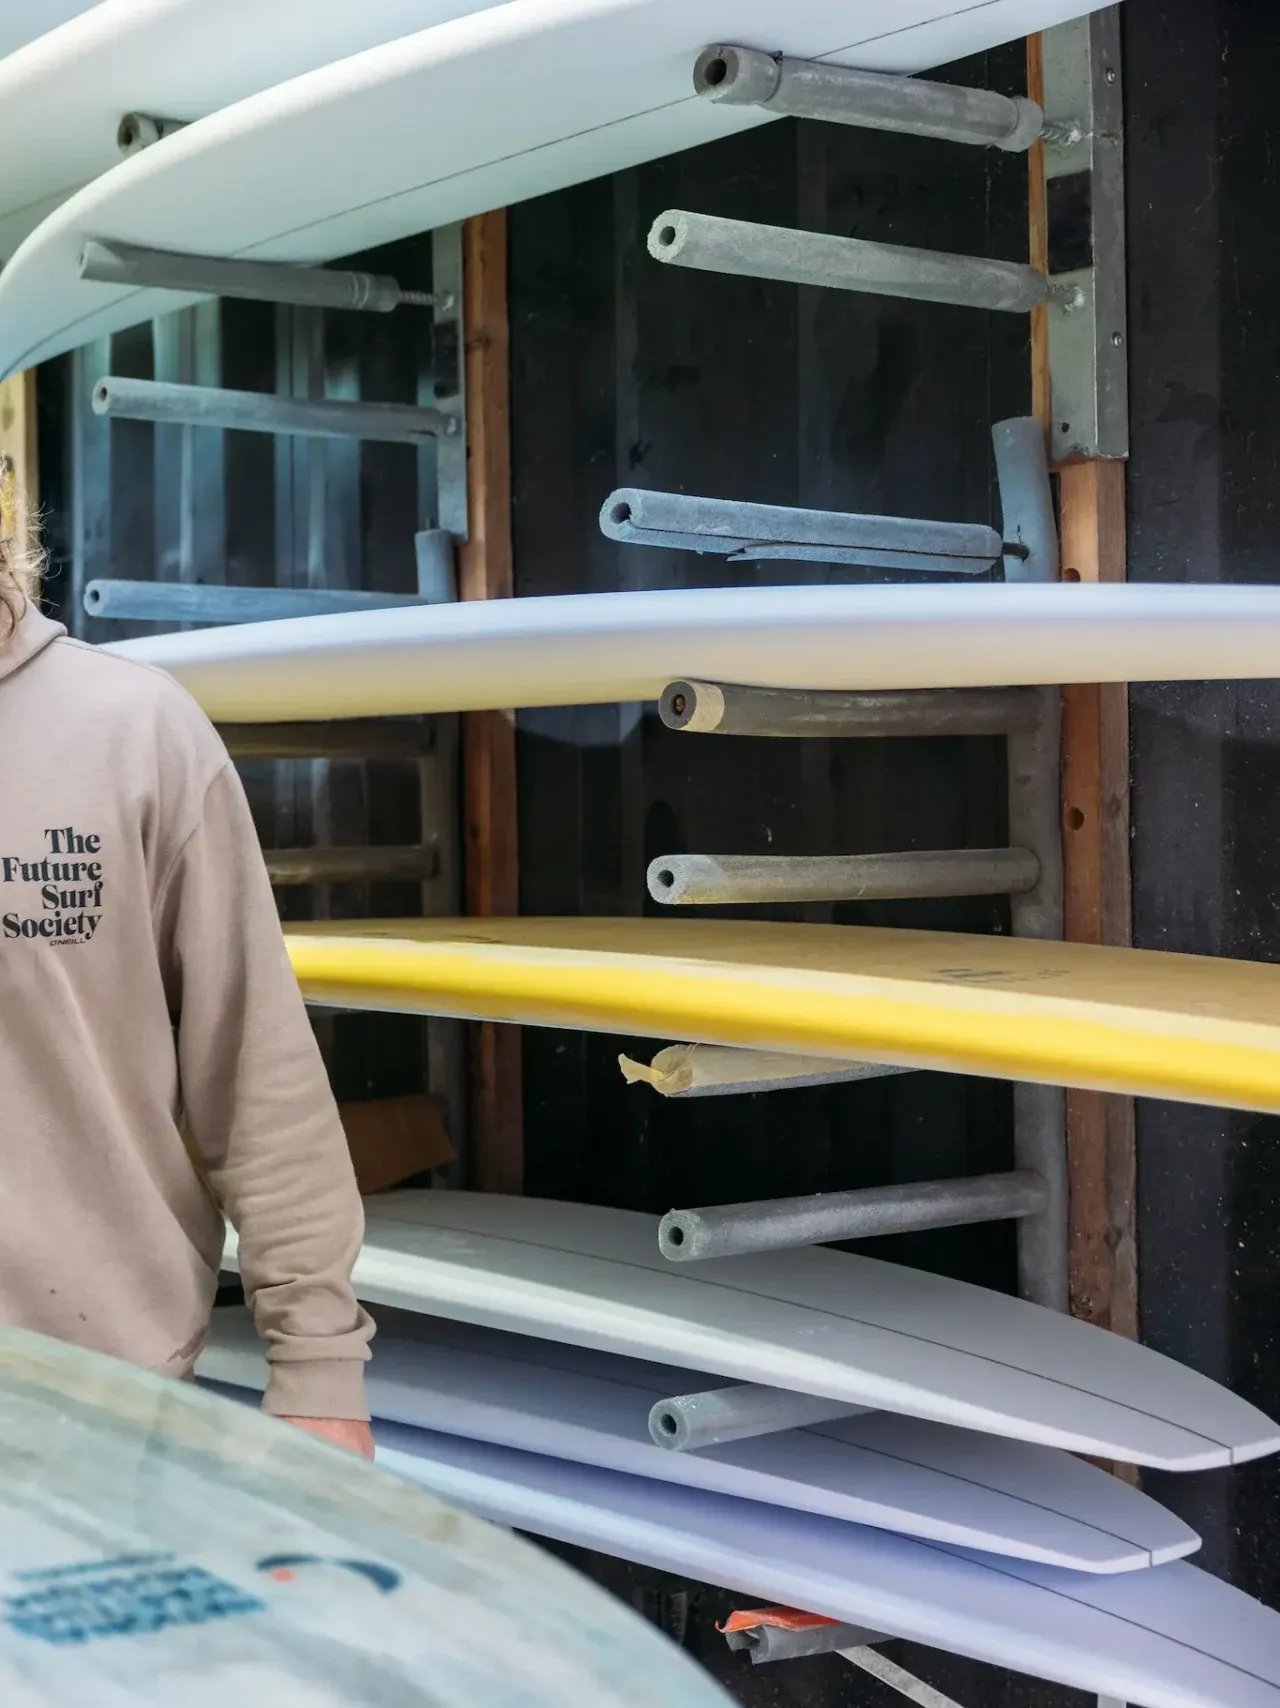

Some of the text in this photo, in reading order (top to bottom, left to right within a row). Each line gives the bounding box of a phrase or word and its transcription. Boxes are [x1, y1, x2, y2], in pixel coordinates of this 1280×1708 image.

[44, 826, 101, 854] The
[0, 856, 103, 883] Future
[41, 880, 104, 910] Surf
[2, 910, 103, 940] Society
